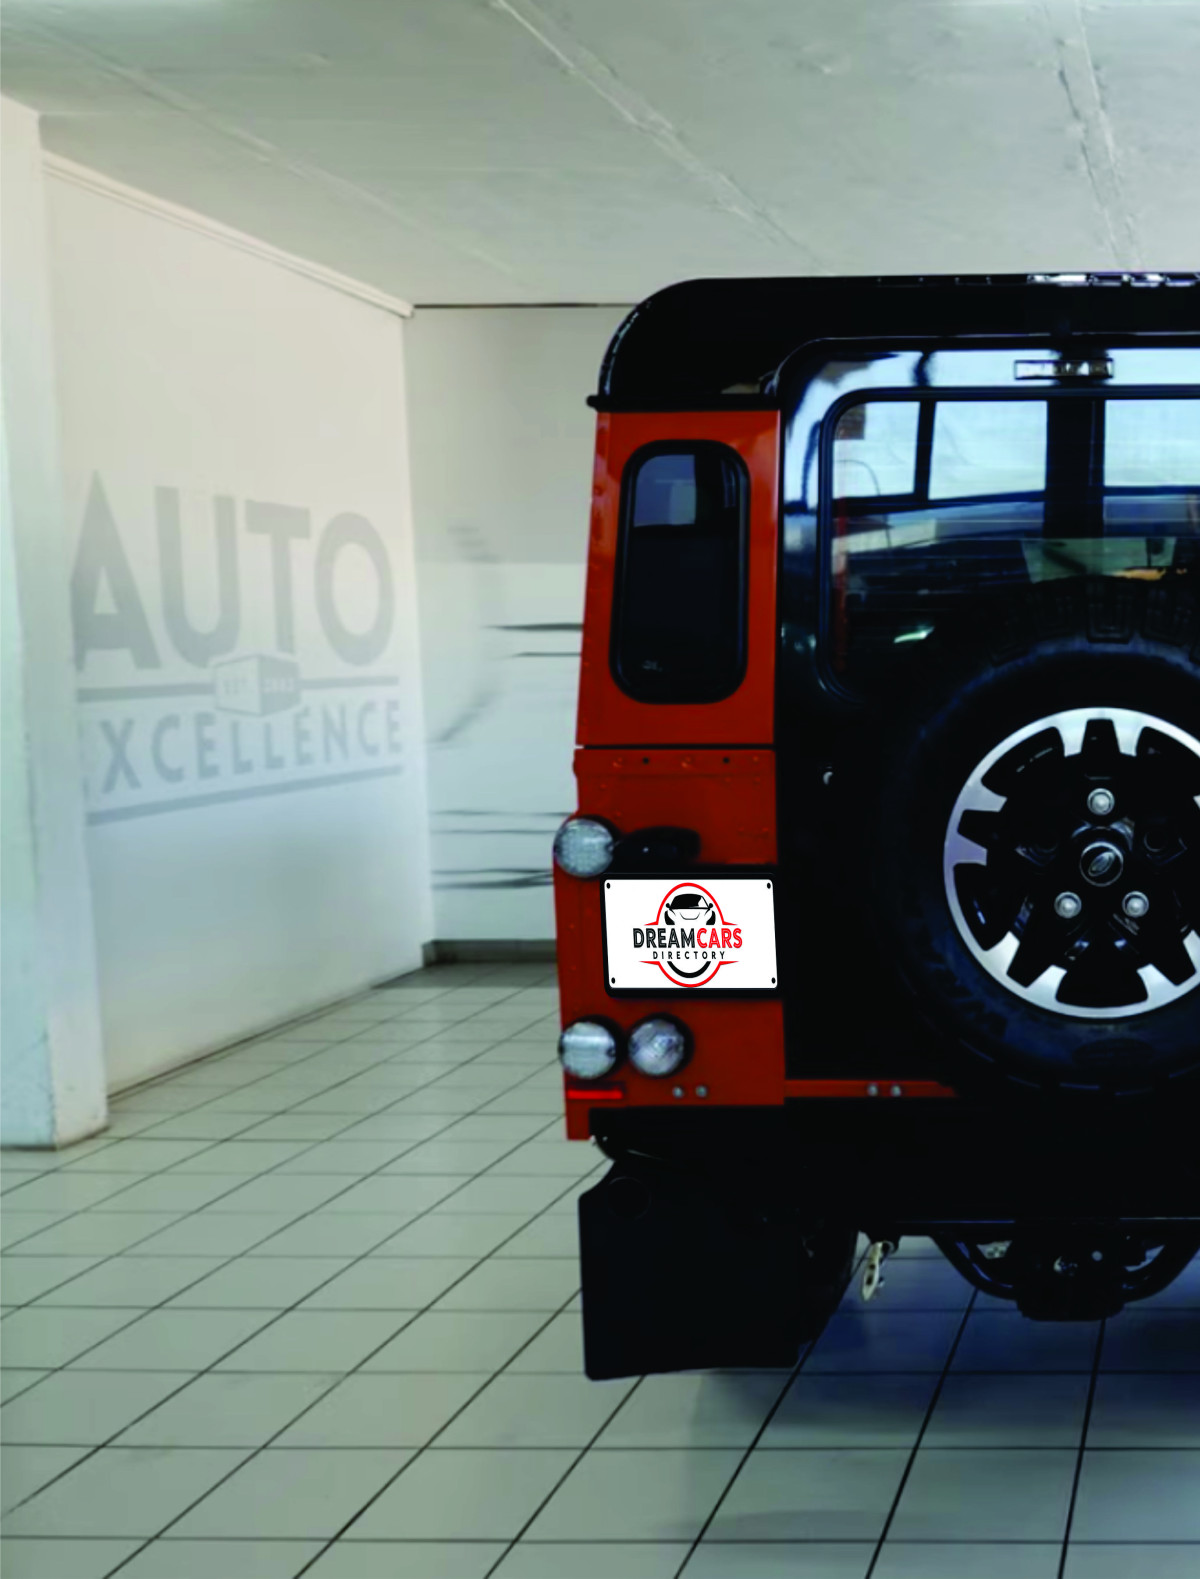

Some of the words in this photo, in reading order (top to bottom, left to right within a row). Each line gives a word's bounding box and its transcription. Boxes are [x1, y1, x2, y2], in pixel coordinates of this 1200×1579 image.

[70, 469, 395, 671] AUTO
[83, 699, 403, 797] XCELLENCE
[632, 927, 743, 949] DREAMCARS
[652, 950, 726, 960] DIRECTORY
